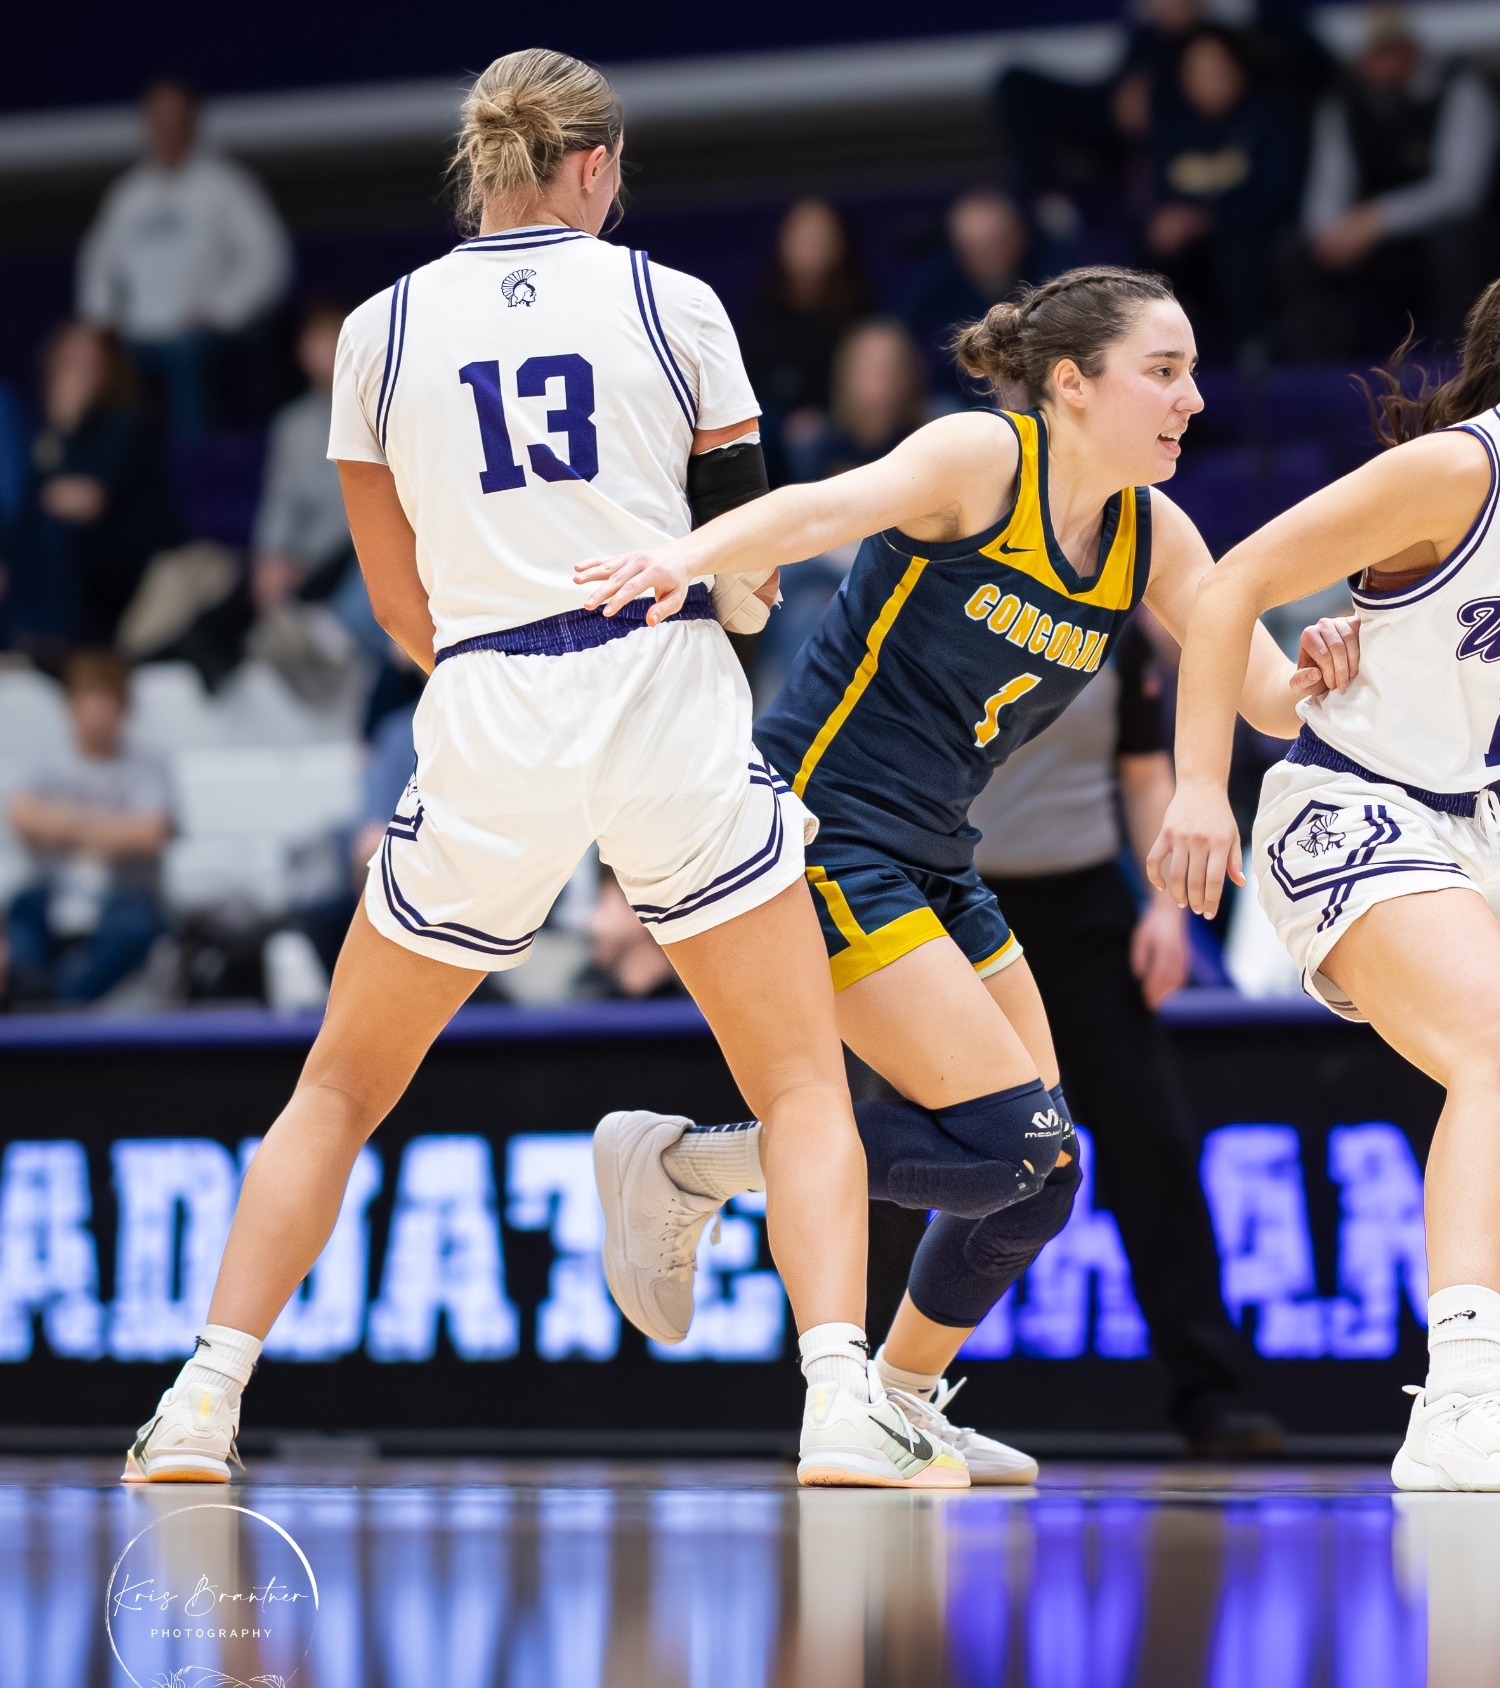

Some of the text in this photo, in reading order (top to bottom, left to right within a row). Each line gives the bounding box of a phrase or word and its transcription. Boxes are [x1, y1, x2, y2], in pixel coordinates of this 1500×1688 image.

[458, 352, 600, 495] 13
[964, 583, 1109, 673] CONCORDI
[973, 672, 1043, 749] 1
